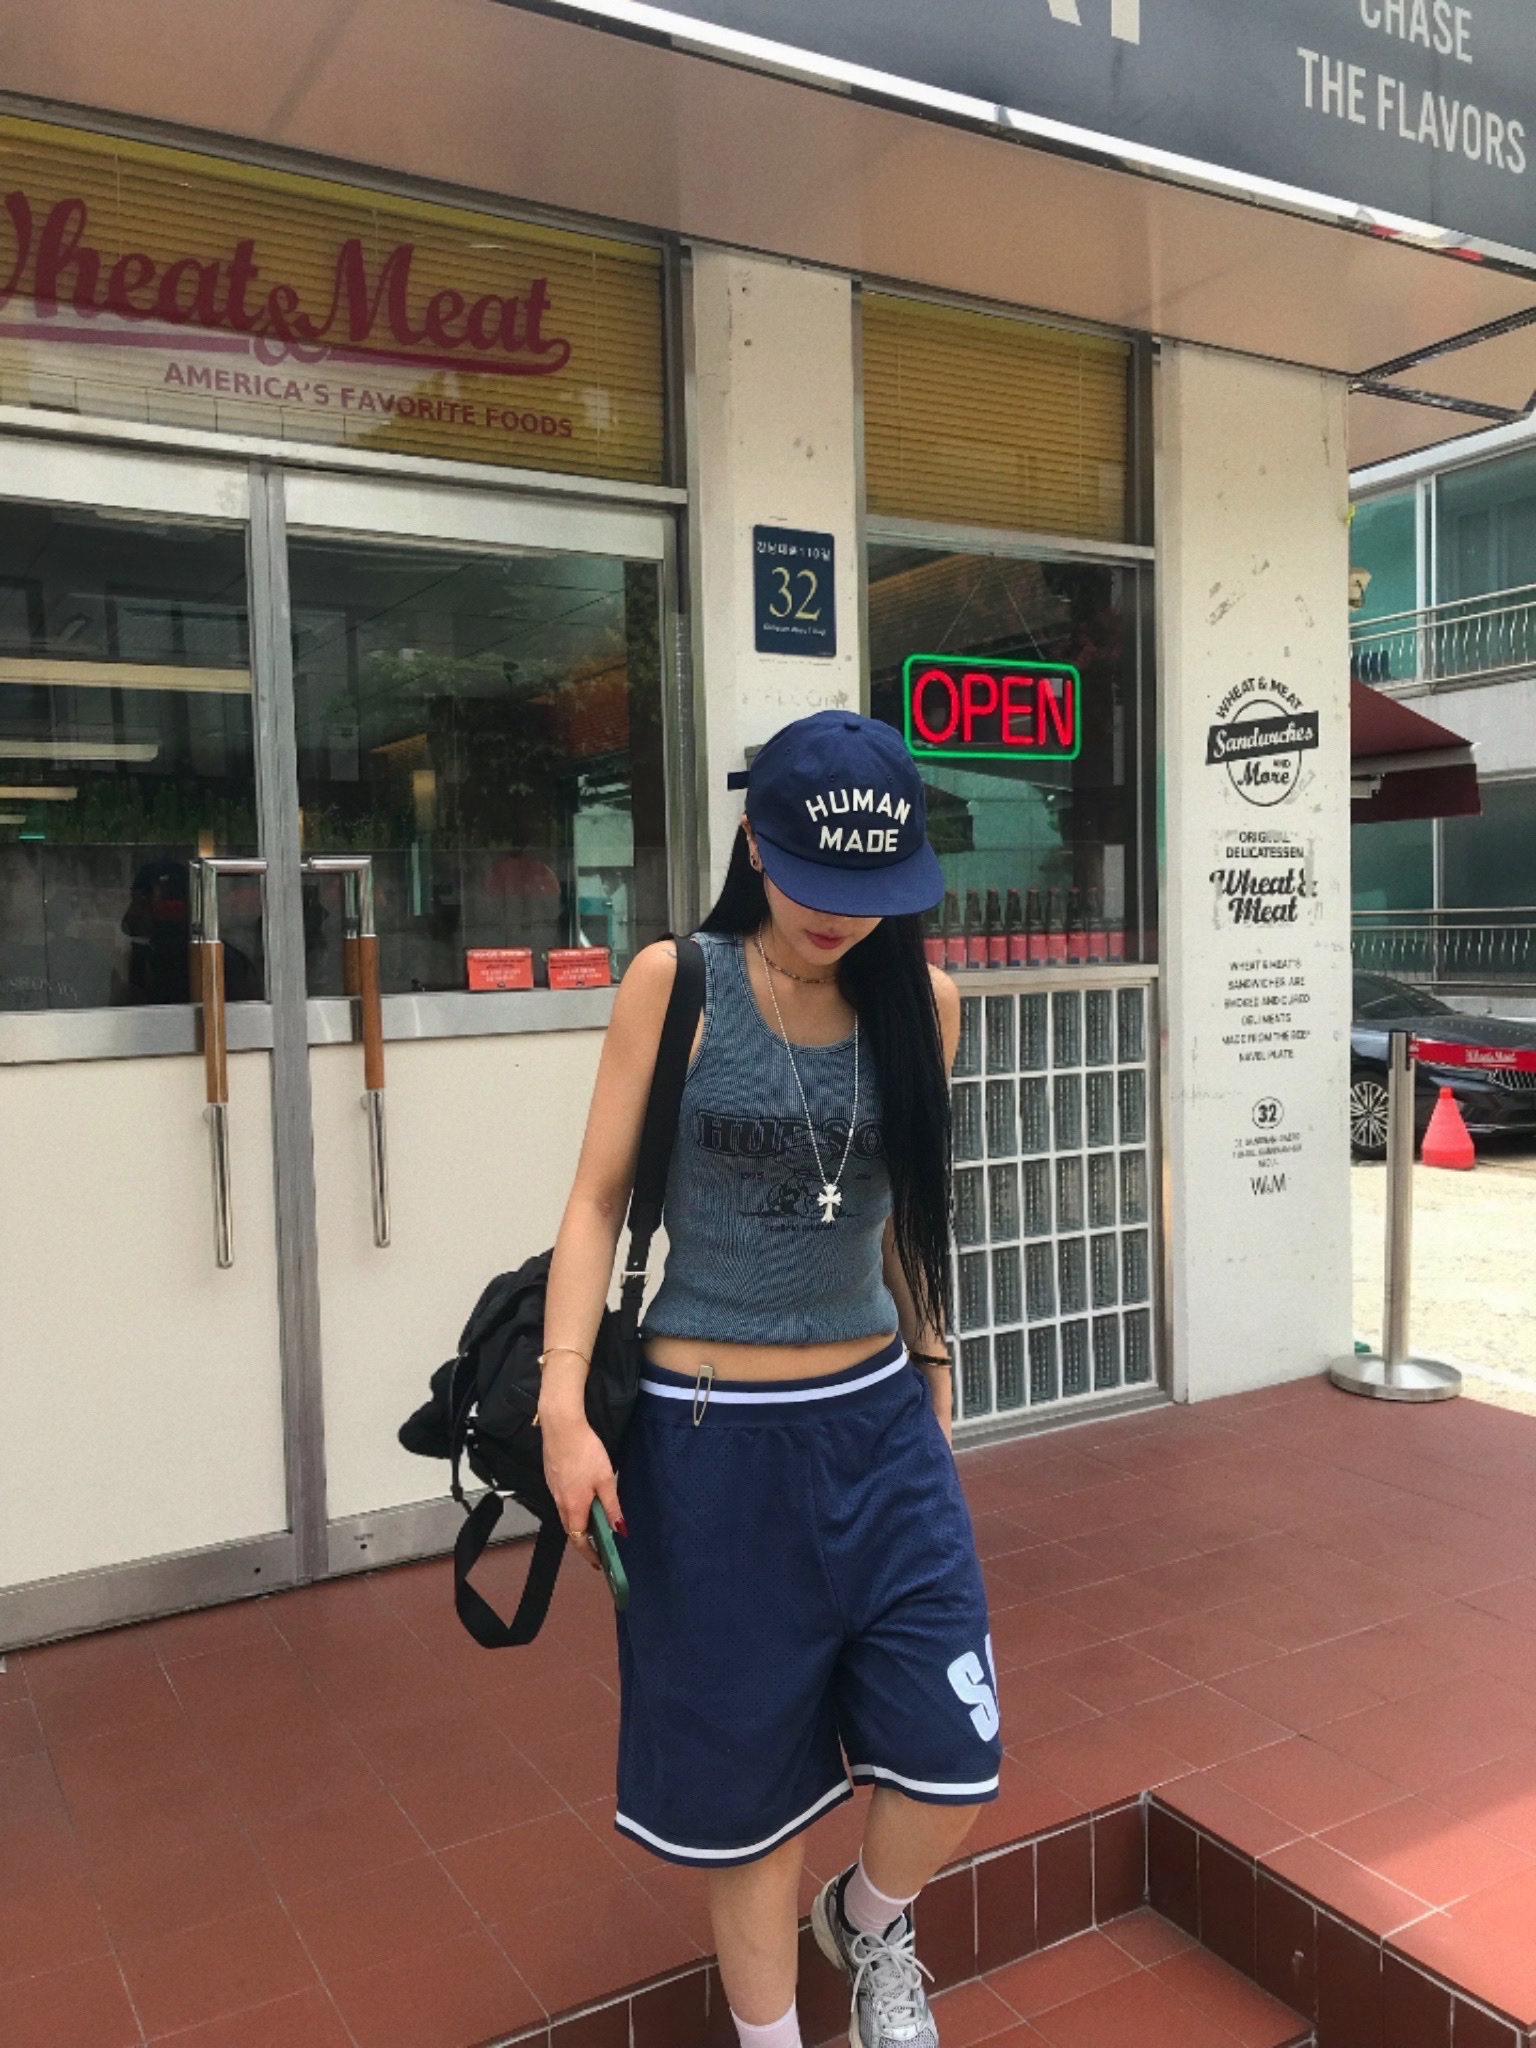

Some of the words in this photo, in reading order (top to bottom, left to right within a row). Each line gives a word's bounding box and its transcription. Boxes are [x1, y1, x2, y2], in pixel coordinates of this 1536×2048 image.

[1297, 47, 1366, 125] THE
[1378, 74, 1526, 174] FLAVORS
[163, 362, 329, 406] AMERICA'S
[341, 387, 476, 425] FAVORITE
[485, 408, 573, 438] FOODS
[769, 566, 822, 621] 32
[912, 668, 1073, 747] OPEN
[1216, 678, 1255, 719] WHEAT
[1258, 676, 1268, 691] &
[1269, 679, 1304, 710] MEAT
[1213, 721, 1314, 758] Sandwiches
[1237, 761, 1289, 786] More
[805, 788, 911, 825] HUMAN
[819, 825, 900, 853] MADE
[1226, 846, 1304, 858] DELICATESSEN
[1209, 868, 1295, 896] Wheat
[1228, 896, 1298, 924] Meat
[1257, 1103, 1278, 1123] 32
